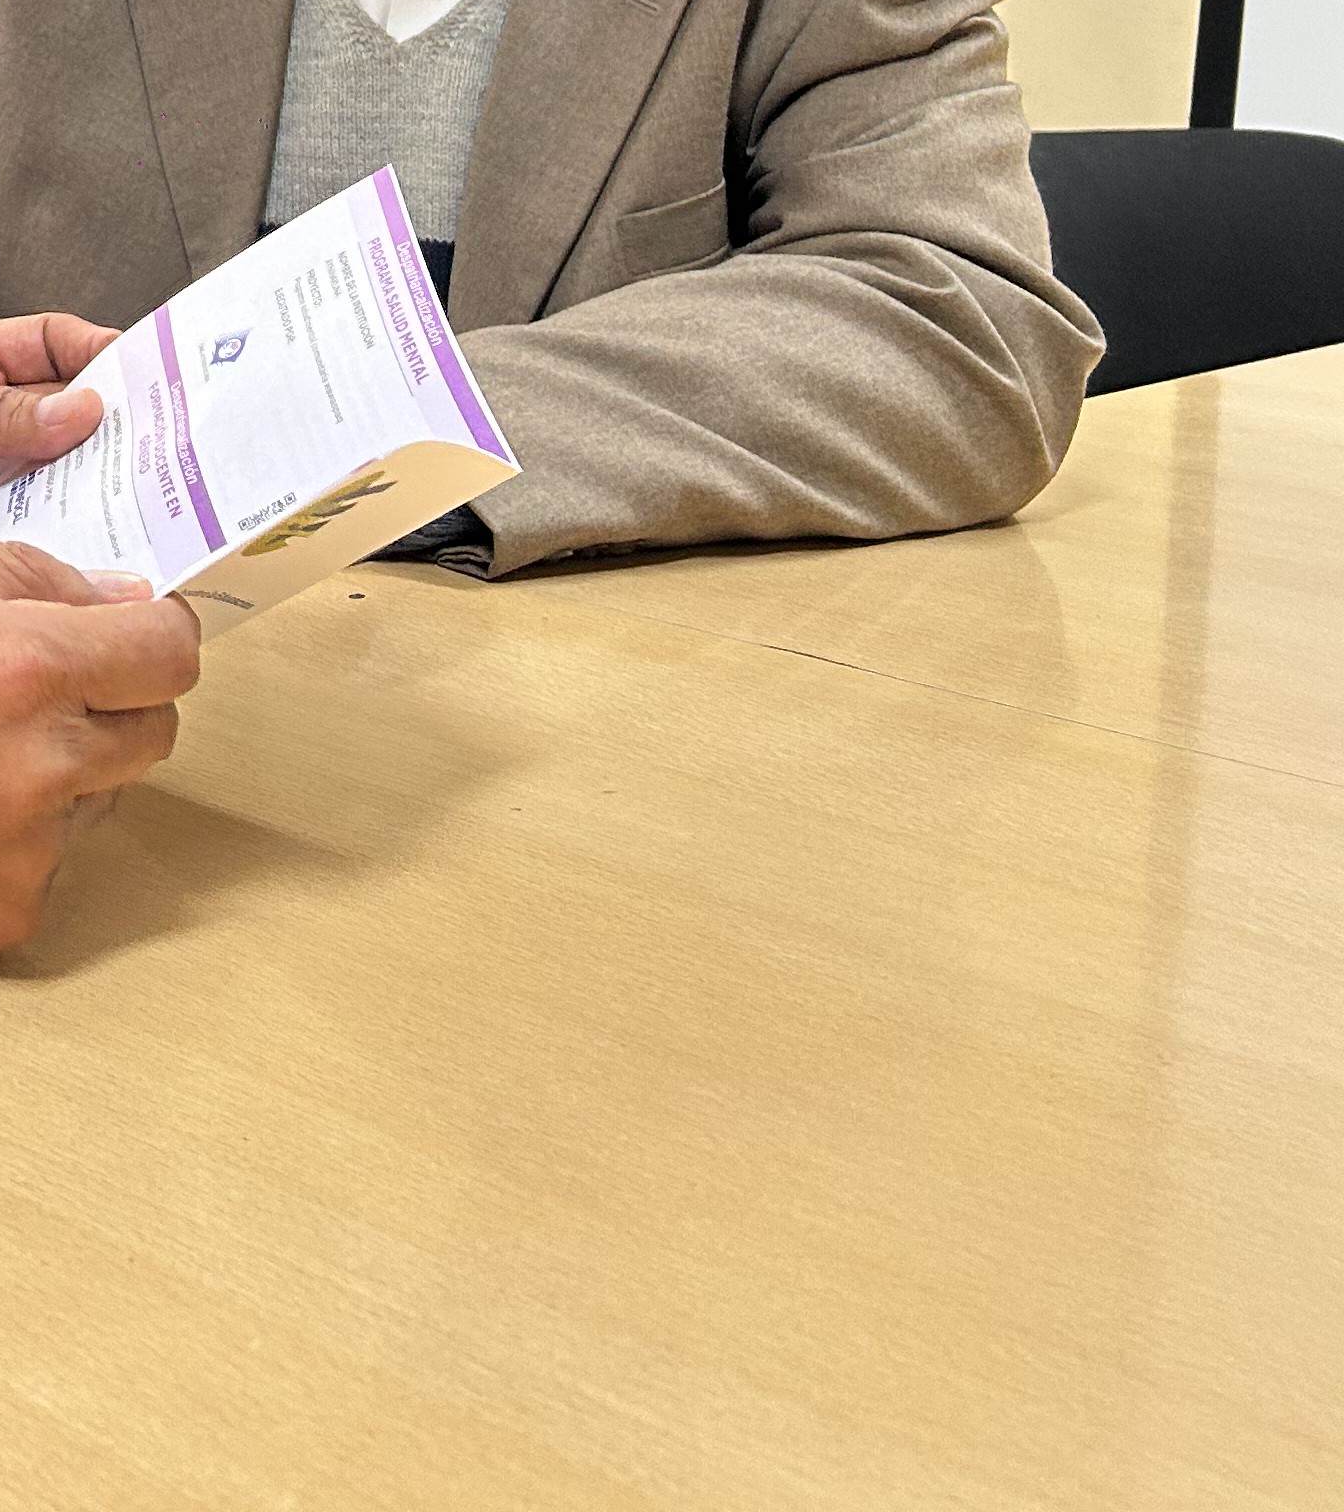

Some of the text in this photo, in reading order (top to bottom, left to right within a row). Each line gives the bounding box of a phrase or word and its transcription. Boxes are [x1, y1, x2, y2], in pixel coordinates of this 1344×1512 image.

[345, 280, 356, 292] DE
[348, 290, 358, 302] LA
[368, 237, 430, 385] PROGRAMA SALUD MENTAL
[396, 241, 442, 346] Despatriarcalización
[149, 382, 182, 518] FORMACIÓN DOCENTE EN
